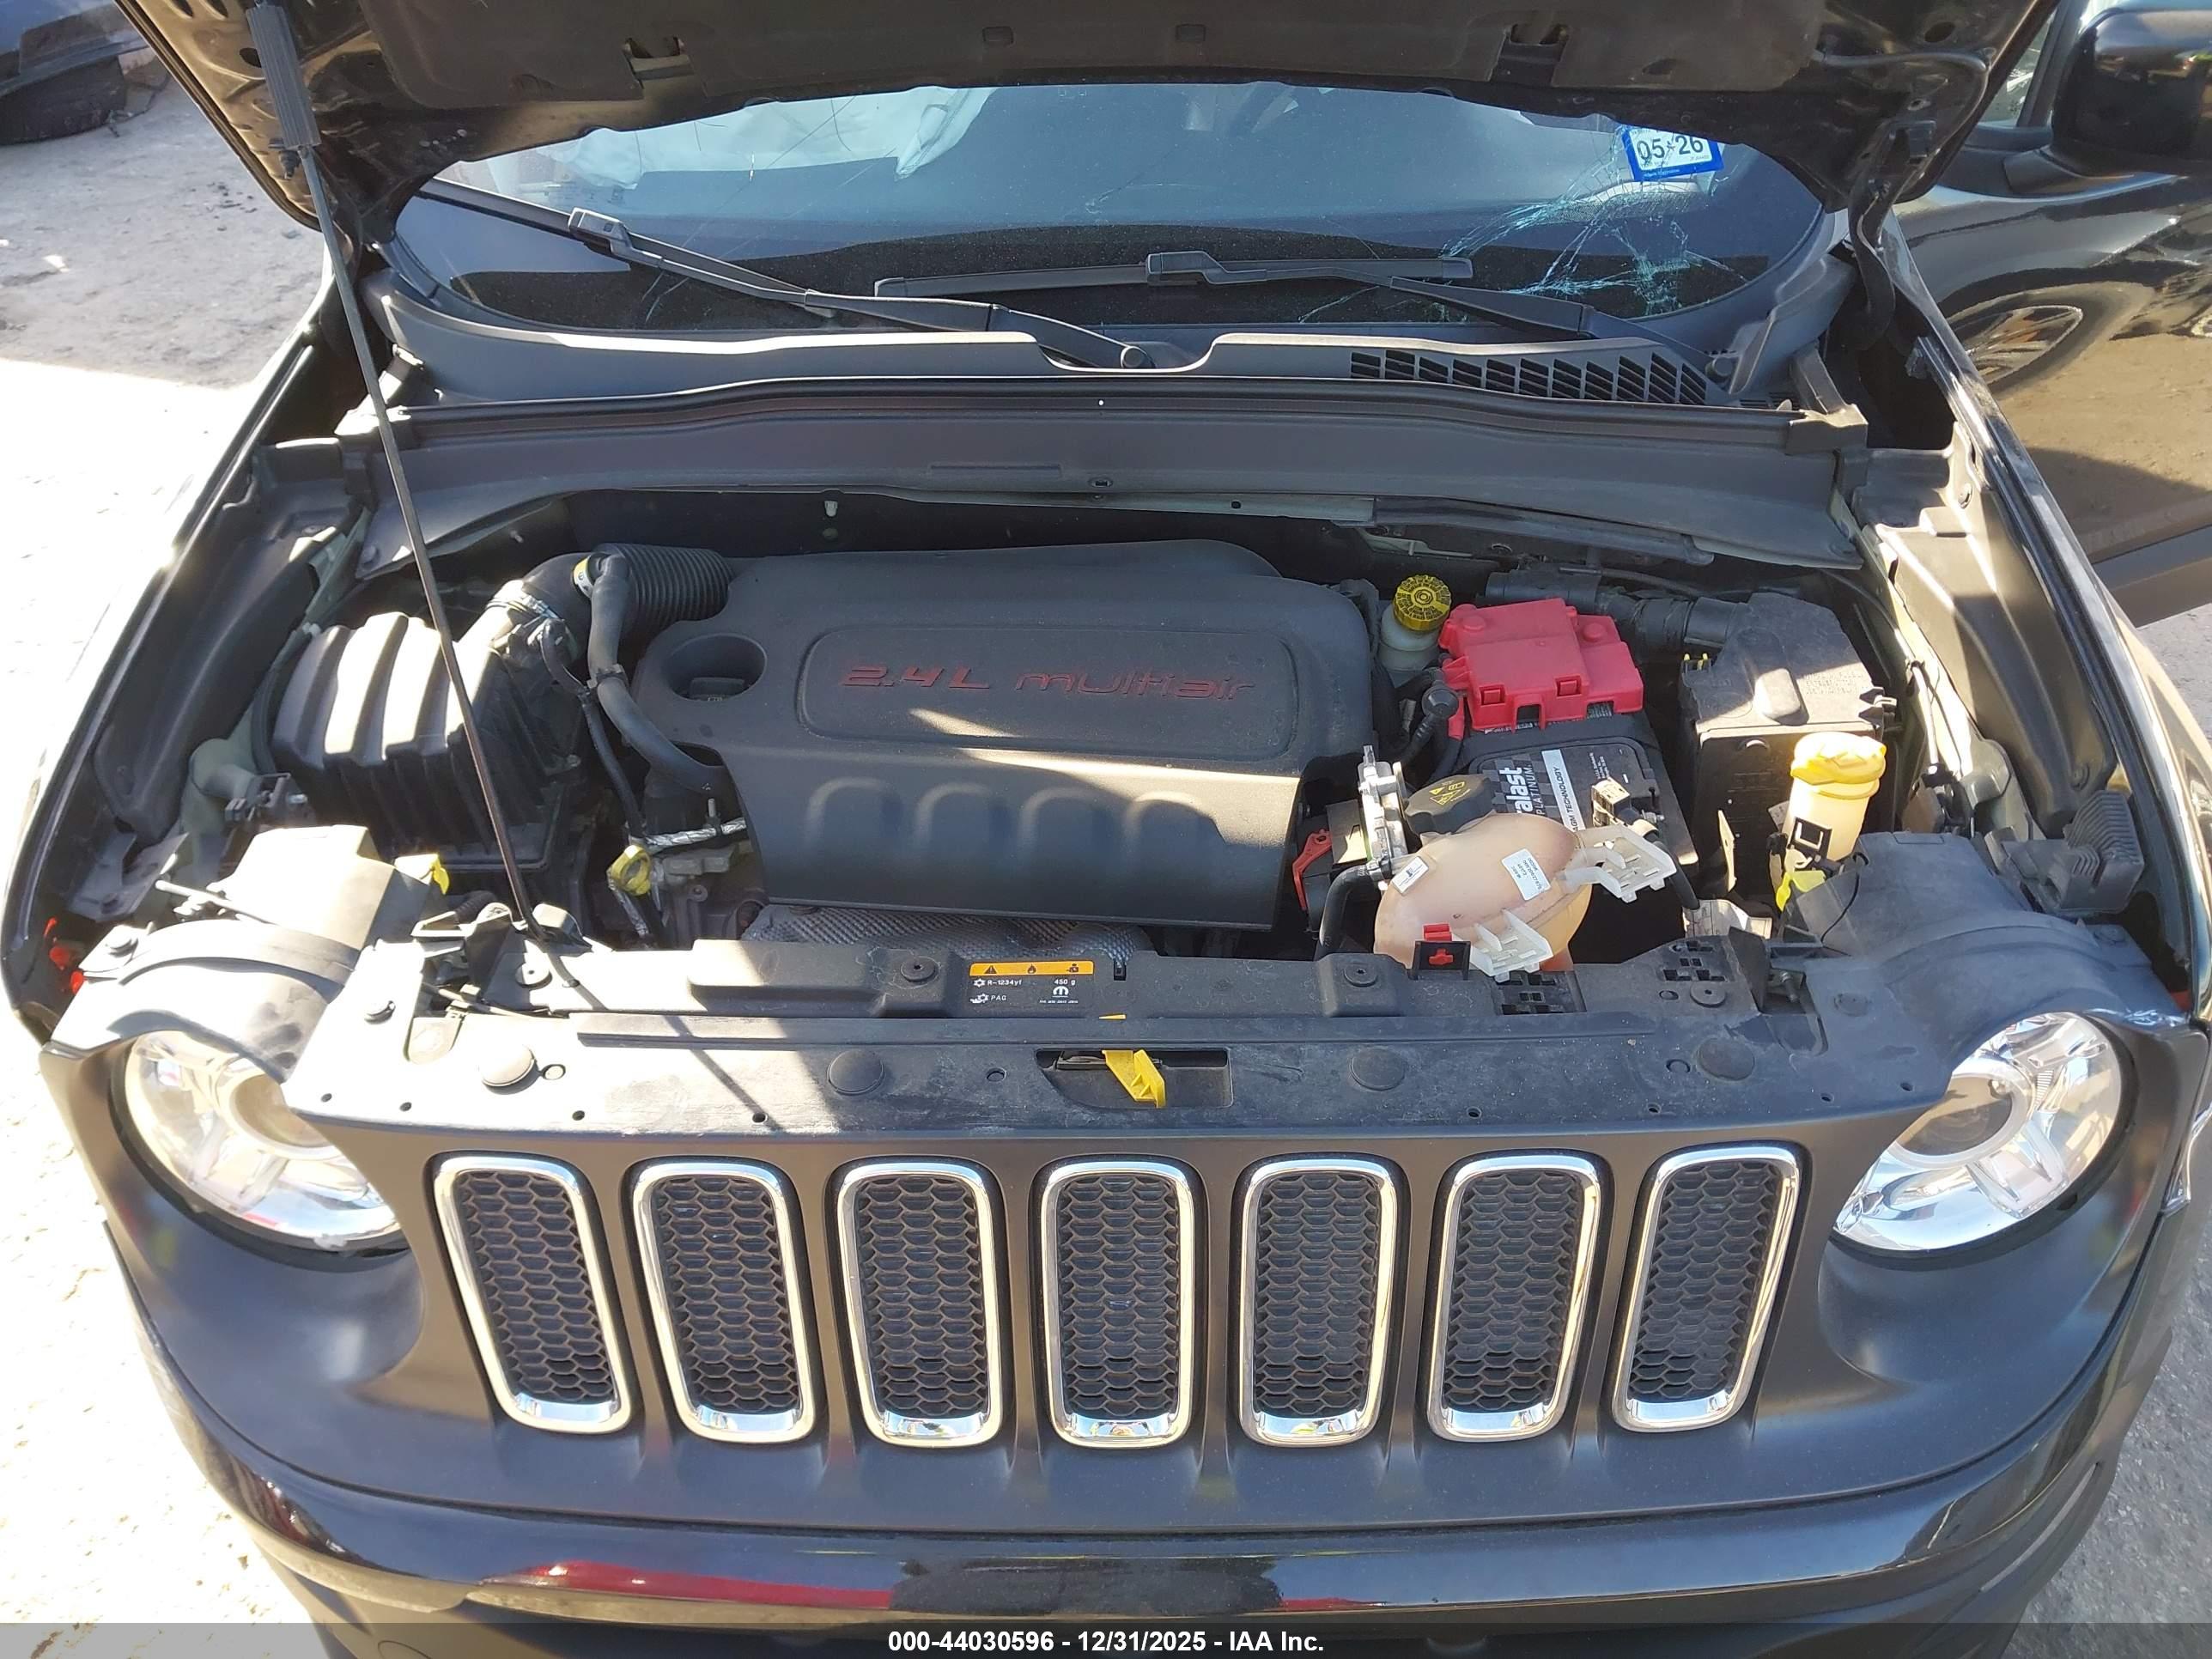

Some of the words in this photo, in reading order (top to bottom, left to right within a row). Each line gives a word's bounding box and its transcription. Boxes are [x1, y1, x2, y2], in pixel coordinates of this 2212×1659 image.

[1636, 138, 1666, 160] 05
[1674, 135, 1704, 155] 26
[1015, 667, 1256, 700] multiair
[1553, 766, 1575, 814] TECHNOLOGY
